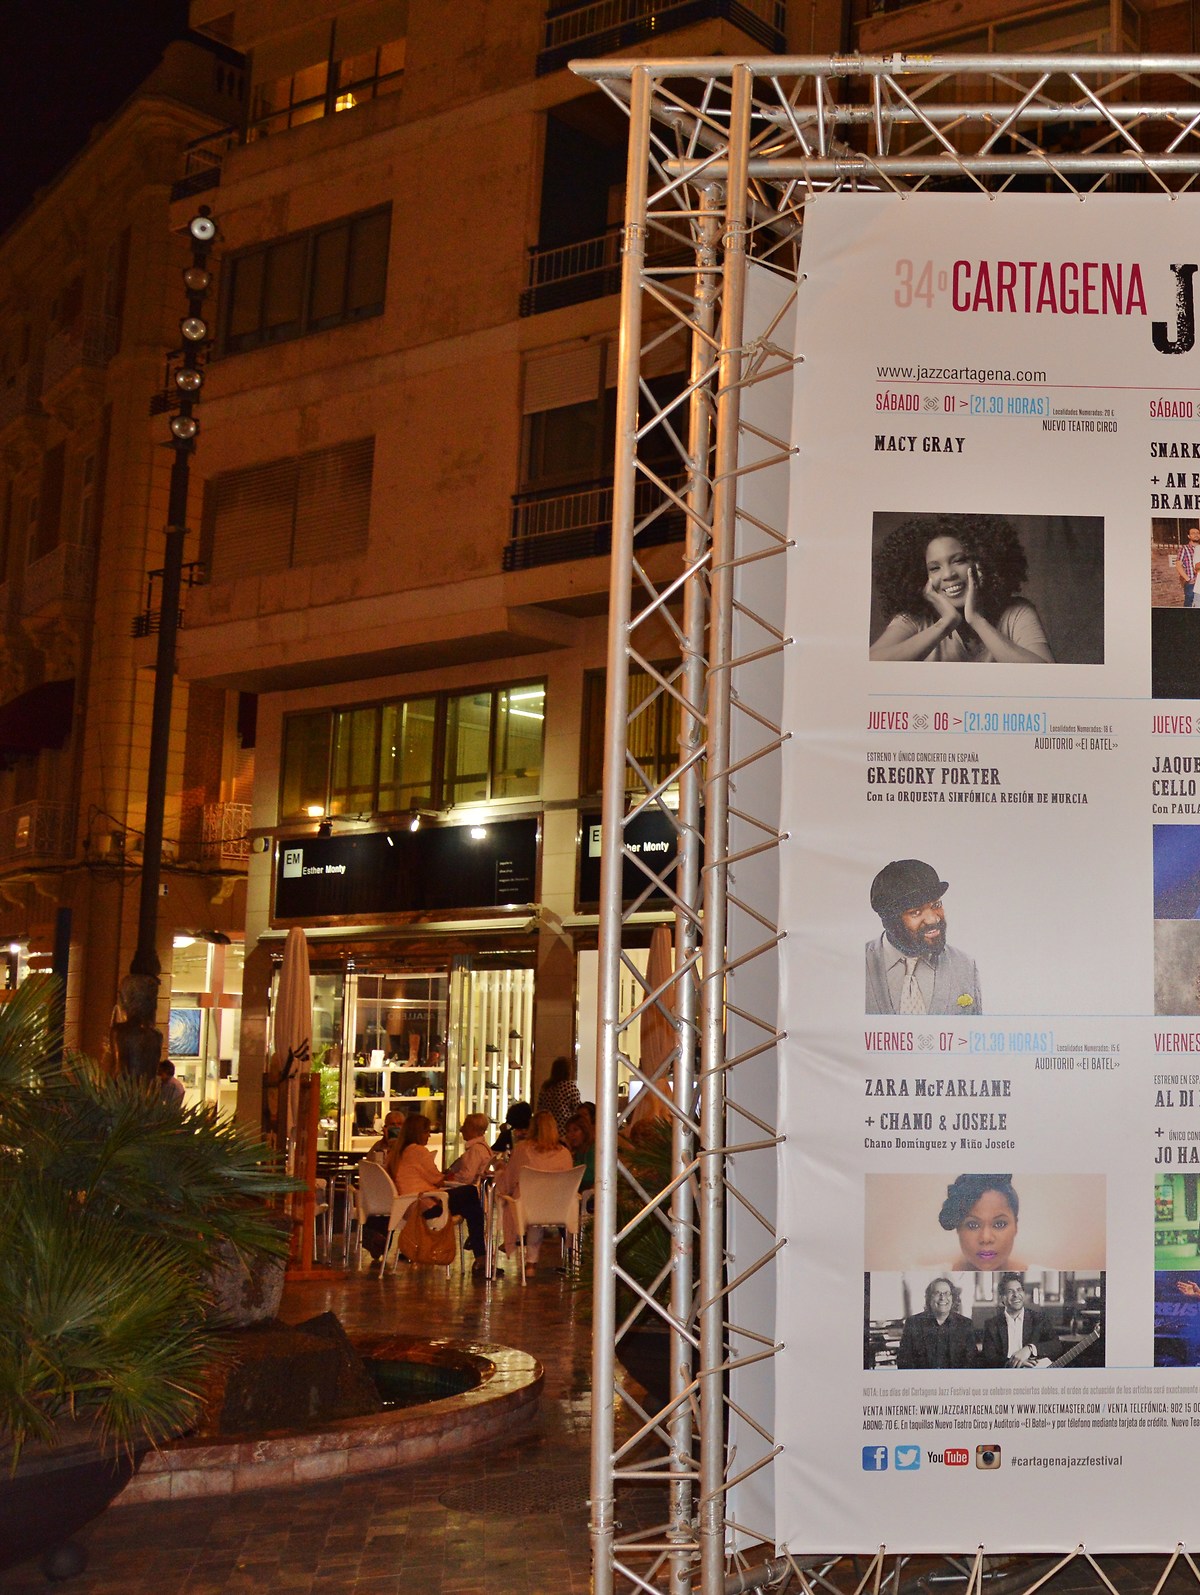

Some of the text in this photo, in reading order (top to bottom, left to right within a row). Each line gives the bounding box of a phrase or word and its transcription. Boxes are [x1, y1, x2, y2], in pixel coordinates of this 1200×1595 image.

[952, 260, 1147, 316] CARTAGENA
[876, 364, 1047, 383] www.jazzcartagena.com
[875, 390, 920, 413] SÁBADO
[944, 395, 955, 412] 01
[1150, 398, 1193, 418] SÁBADO
[1042, 419, 1118, 433] NUEVO TEATRO CIRCO
[874, 435, 966, 453] MACY GRAY
[1165, 472, 1186, 489] AN
[867, 711, 909, 730] JUEVES
[934, 712, 948, 731] 06
[1152, 715, 1192, 734] JUEVES
[867, 767, 1001, 785] GREGORY PORTER
[867, 791, 883, 802] Con
[897, 792, 945, 804] ORQUESTA
[949, 790, 997, 804] SINFÓNICA
[1001, 790, 1034, 804] REGIÓN
[1037, 793, 1048, 804] DE
[1051, 793, 1088, 804] MURCIA
[1152, 779, 1196, 797] CELLO
[1152, 804, 1168, 814] Con
[644, 841, 669, 852] Monty
[287, 854, 299, 864] EM
[303, 865, 346, 875] Esther Monty
[865, 1031, 914, 1051] VIERNES
[939, 1032, 954, 1051] 07
[865, 1079, 1012, 1097] ZARA McFARLANE
[1155, 1090, 1174, 1107] AL
[1180, 1090, 1194, 1107] DI
[880, 1113, 1008, 1131] CHANO & JOSELE
[865, 1137, 1015, 1151] Chano Domínguez y Niño Josele
[1154, 1146, 1172, 1164] JO
[863, 1406, 883, 1415] VENTA
[885, 1405, 917, 1415] INTERNET:
[920, 1404, 1008, 1415] WWW.JAZZCARTAGENA.COM
[1017, 1403, 1100, 1414] WWW.TICKETMASTER.COM
[1108, 1403, 1127, 1413] VENTA
[1130, 1401, 1168, 1413] TELEFÓNICA:
[1171, 1403, 1182, 1413] 902
[1185, 1403, 1191, 1412] 15
[1194, 1402, 1200, 1412] 00
[1011, 1456, 1122, 1468] #cartagenajazzfestival
